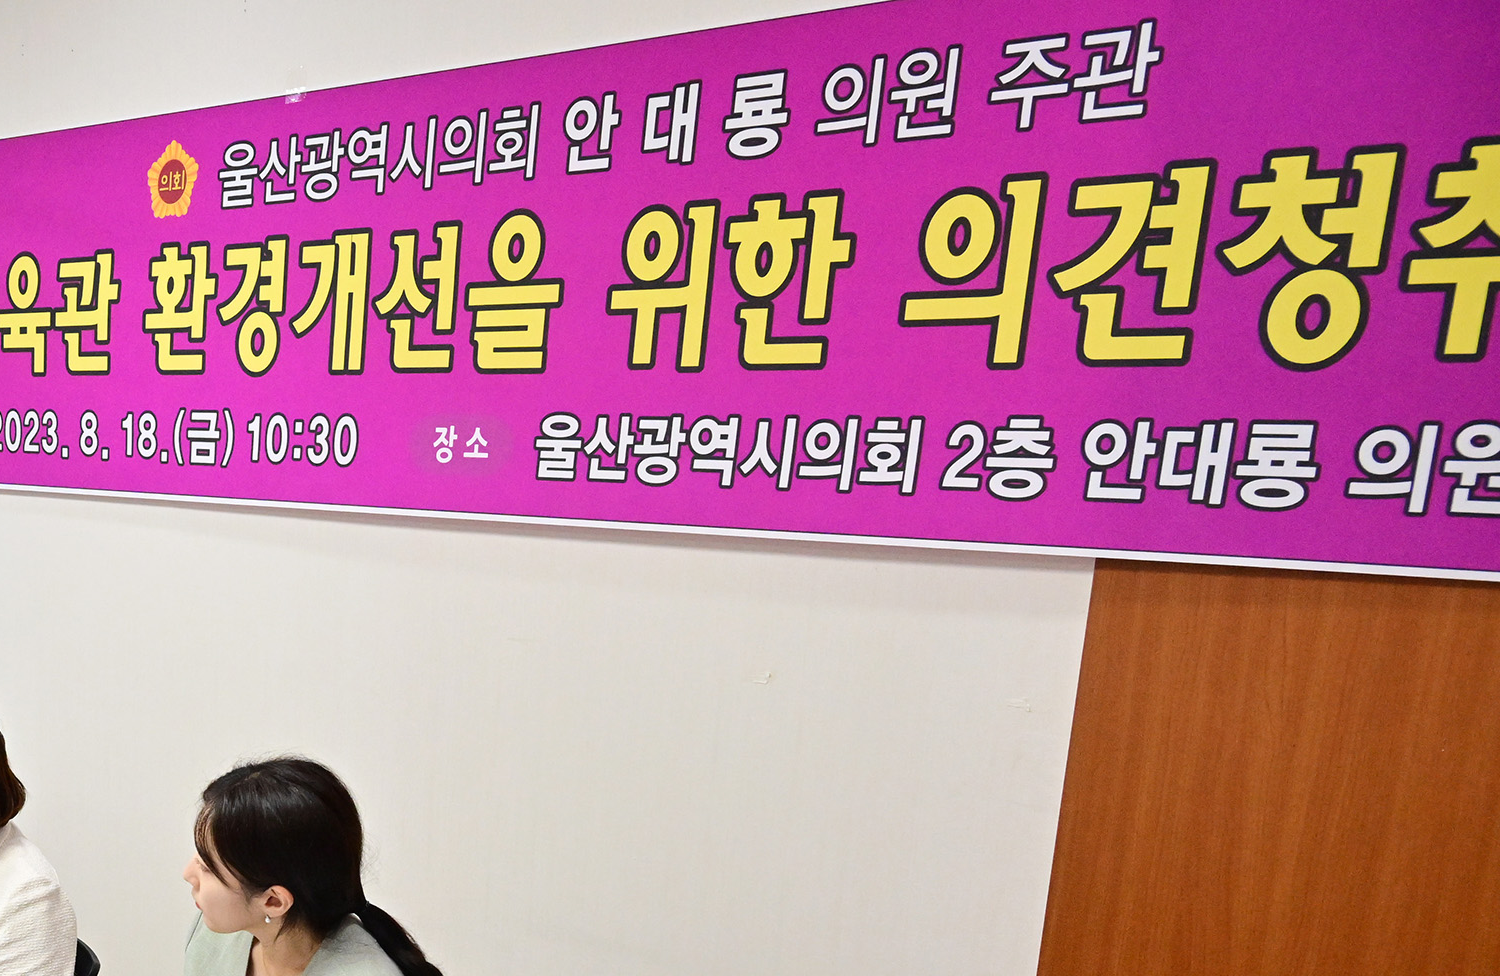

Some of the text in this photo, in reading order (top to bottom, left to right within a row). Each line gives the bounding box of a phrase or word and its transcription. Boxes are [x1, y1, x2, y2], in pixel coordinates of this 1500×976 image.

[219, 104, 542, 210] 울산광역시의회
[815, 44, 963, 149] 의원
[990, 19, 1164, 132] 주관
[159, 170, 186, 192] 의회
[141, 207, 566, 379] 환경개선을
[605, 188, 856, 372] 위한
[78, 409, 111, 461] 8.
[246, 413, 359, 468] 10:30
[533, 411, 926, 497] 울산광역시의회
[938, 414, 1056, 502] 2층
[1083, 418, 1320, 513] 안대룡
